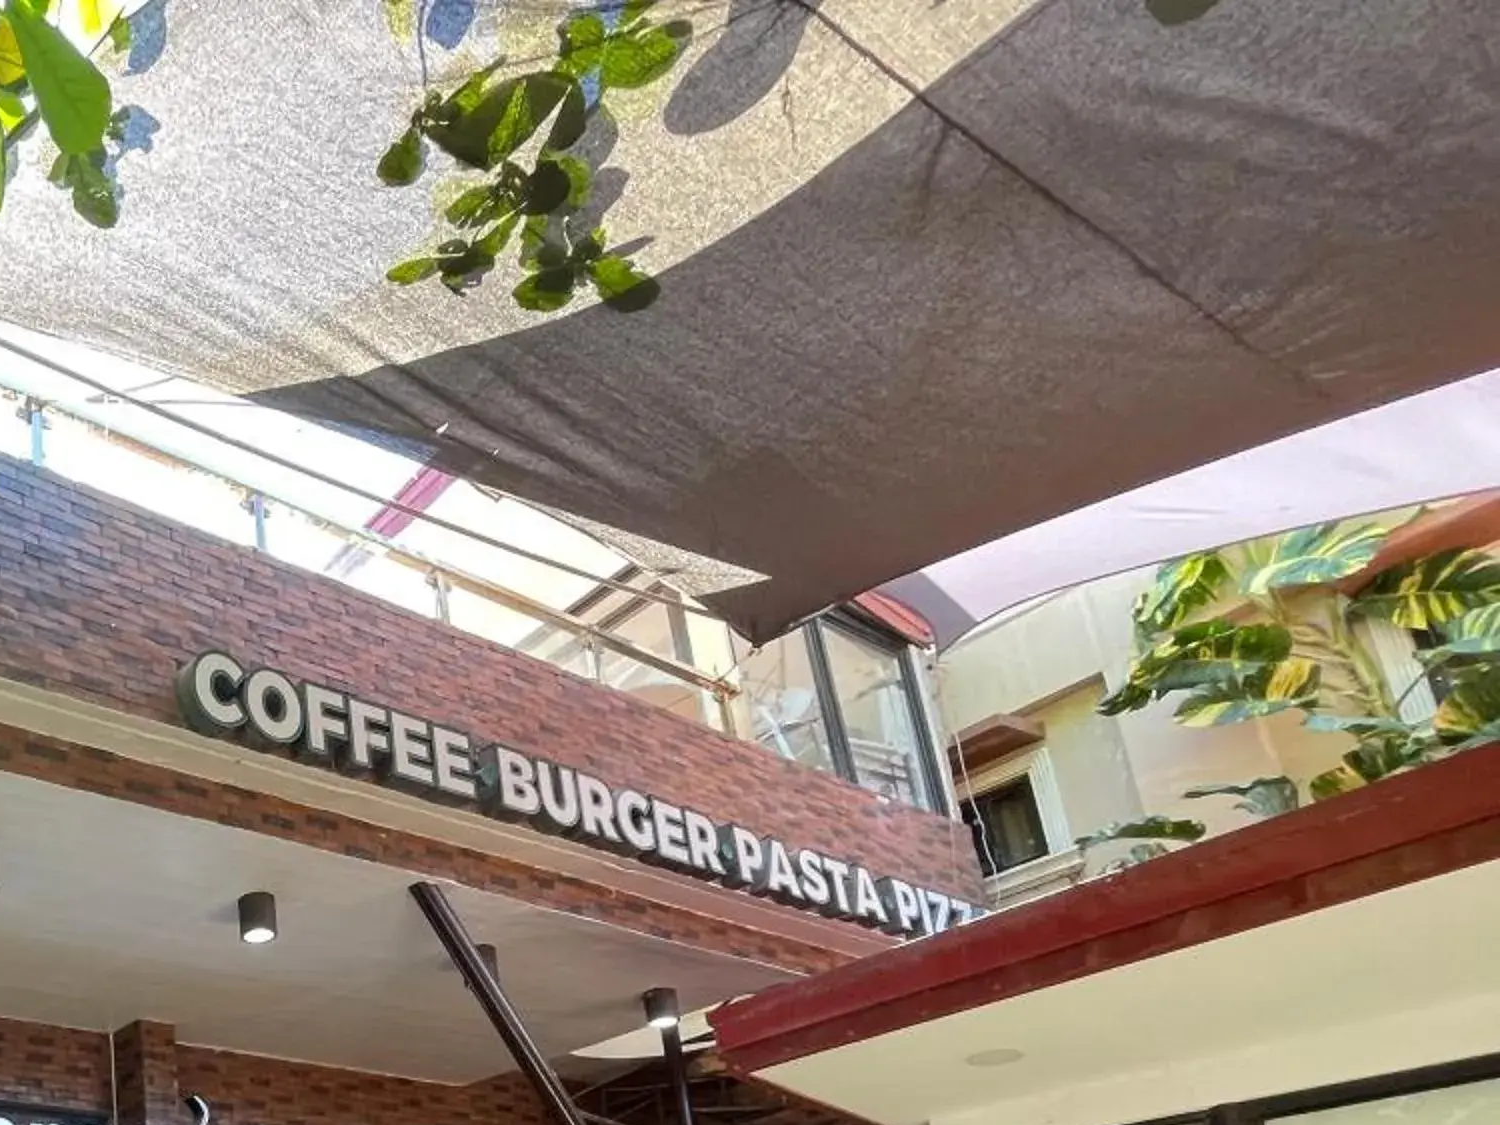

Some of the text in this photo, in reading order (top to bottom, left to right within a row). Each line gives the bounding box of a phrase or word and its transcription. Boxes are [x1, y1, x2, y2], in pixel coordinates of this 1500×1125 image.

[192, 653, 477, 797] COFFEE
[497, 747, 721, 873] BURGER
[734, 828, 889, 923] PASTA
